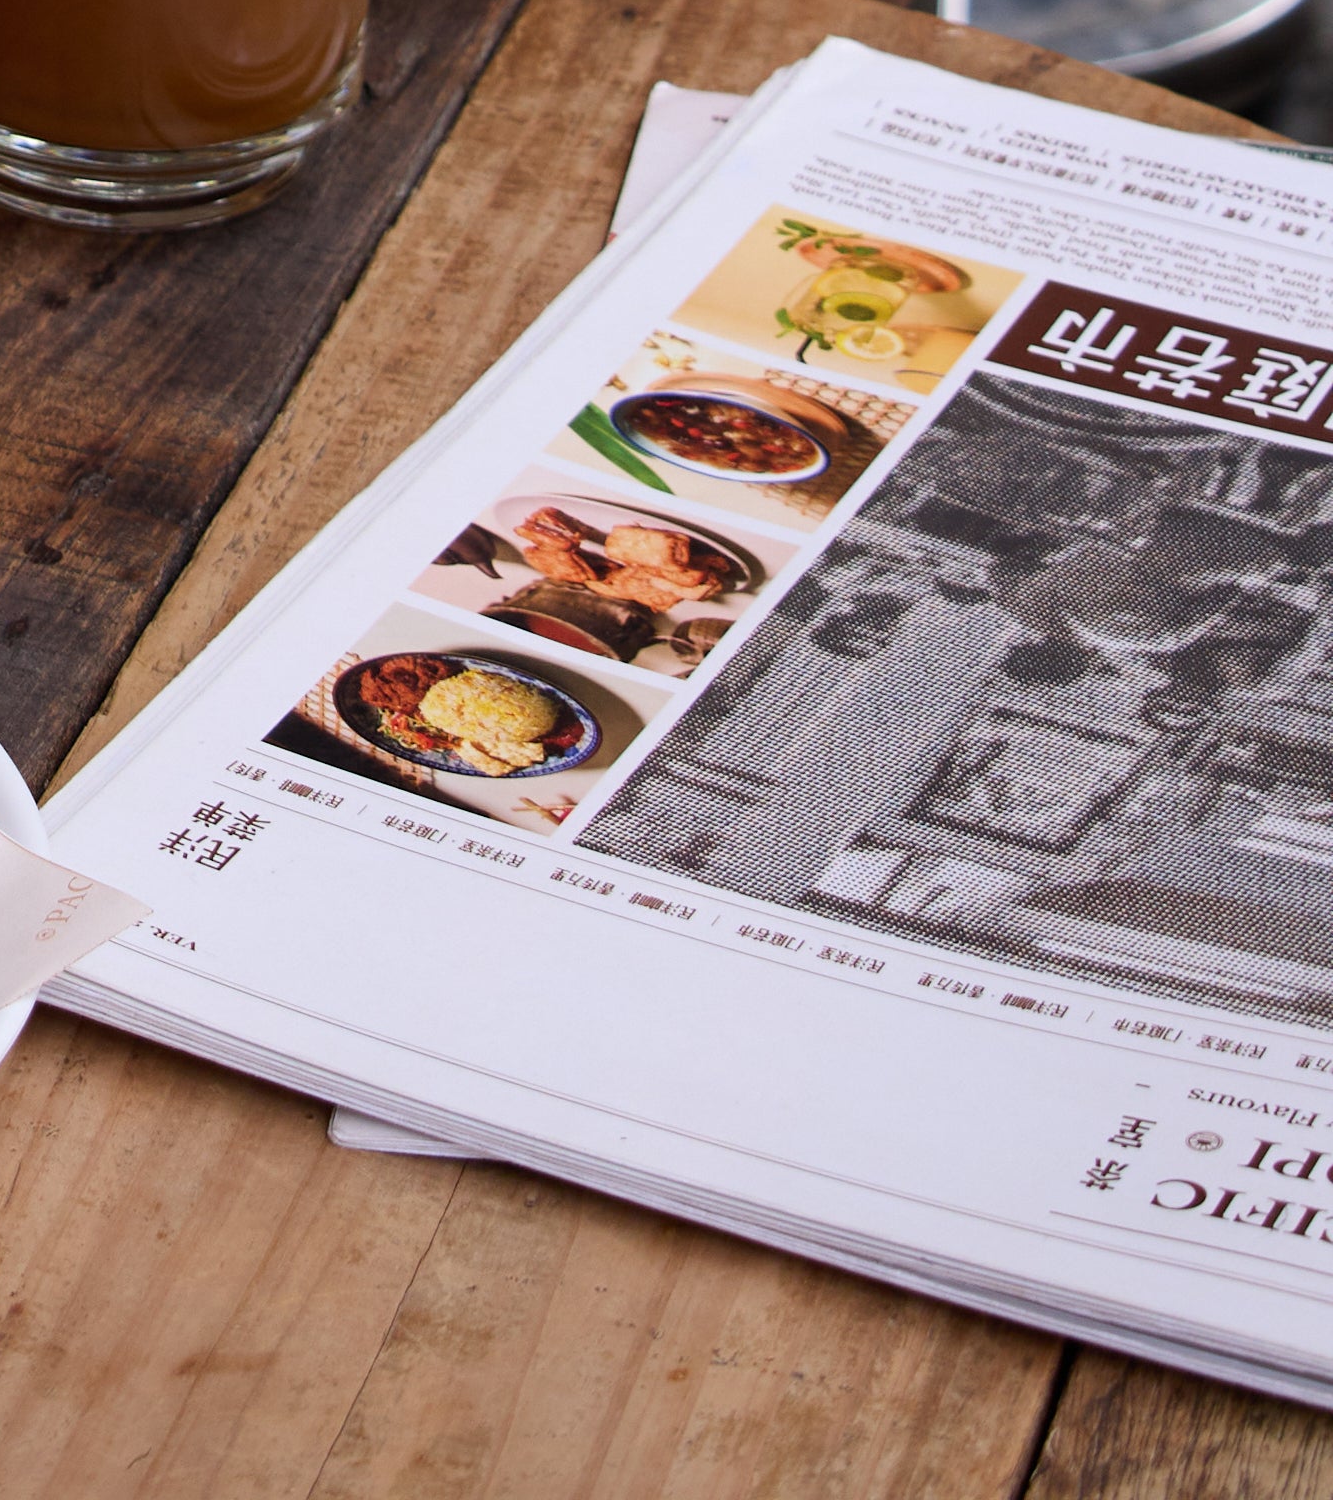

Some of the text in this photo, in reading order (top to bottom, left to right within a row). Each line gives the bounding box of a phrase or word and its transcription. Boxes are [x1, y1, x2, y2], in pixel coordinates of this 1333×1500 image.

[890, 106, 970, 135] SNACKS
[998, 136, 1058, 158] FRIED
[1014, 128, 1089, 154] DRINKS
[1141, 168, 1196, 190] FOOD
[1192, 171, 1308, 206] BREAKFAST
[938, 201, 989, 222] Pacific
[943, 192, 982, 209] Plum
[909, 205, 960, 226] Pacific
[1028, 214, 1079, 235] Pacific
[1096, 219, 1127, 234] Rice
[1067, 235, 1110, 253] Fried
[1132, 228, 1174, 245] Fried
[1014, 245, 1065, 264] Pacific
[1059, 244, 1089, 258] Pan
[1151, 243, 1212, 266] Fungus
[1178, 240, 1229, 259] Pacific
[1069, 258, 1131, 281] Tender,
[1096, 254, 1135, 270] Mala
[1216, 261, 1258, 278] Snow
[1132, 275, 1198, 299] Chicken
[1140, 266, 1206, 289] Chicken
[1281, 277, 1320, 294] Gum
[1201, 293, 1254, 313] Lemak
[1211, 284, 1298, 312] Mushroom
[1268, 286, 1320, 306] Pacific
[1027, 307, 1333, 430] 庭若市
[188, 798, 271, 843] 菜单
[156, 827, 241, 873] 民洋
[149, 925, 197, 952] VER.
[1187, 1088, 1321, 1129] Flavours
[1079, 1115, 1156, 1191] 茶室
[1150, 1178, 1333, 1244] IFIC
